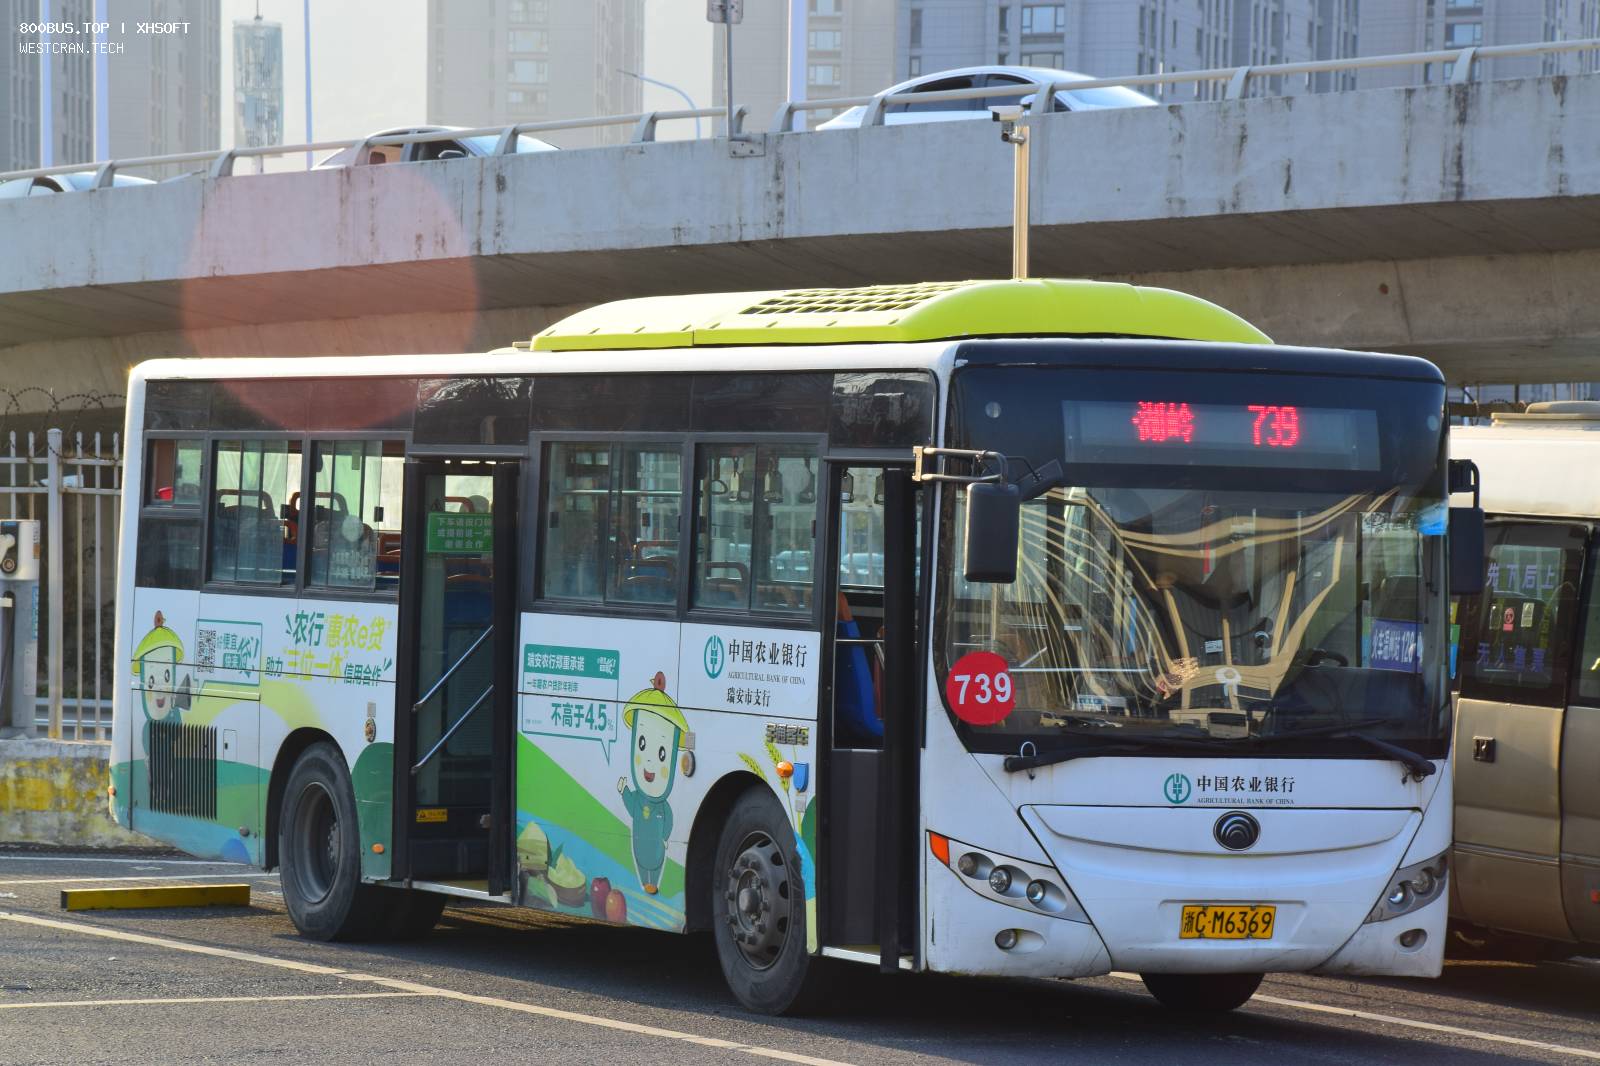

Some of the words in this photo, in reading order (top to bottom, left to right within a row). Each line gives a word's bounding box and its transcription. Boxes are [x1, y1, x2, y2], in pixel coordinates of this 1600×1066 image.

[1247, 404, 1299, 446] 739
[1486, 561, 1556, 591] 先下后上
[728, 638, 808, 668] 中国农业银行
[727, 671, 765, 682] AGRICULTURAL
[766, 674, 781, 683] BANK
[781, 675, 789, 684] OF
[789, 676, 806, 686] CHINA
[954, 671, 1012, 705] 739
[727, 686, 771, 707] 瑞安市支行
[1197, 775, 1296, 793] 中国农业银行
